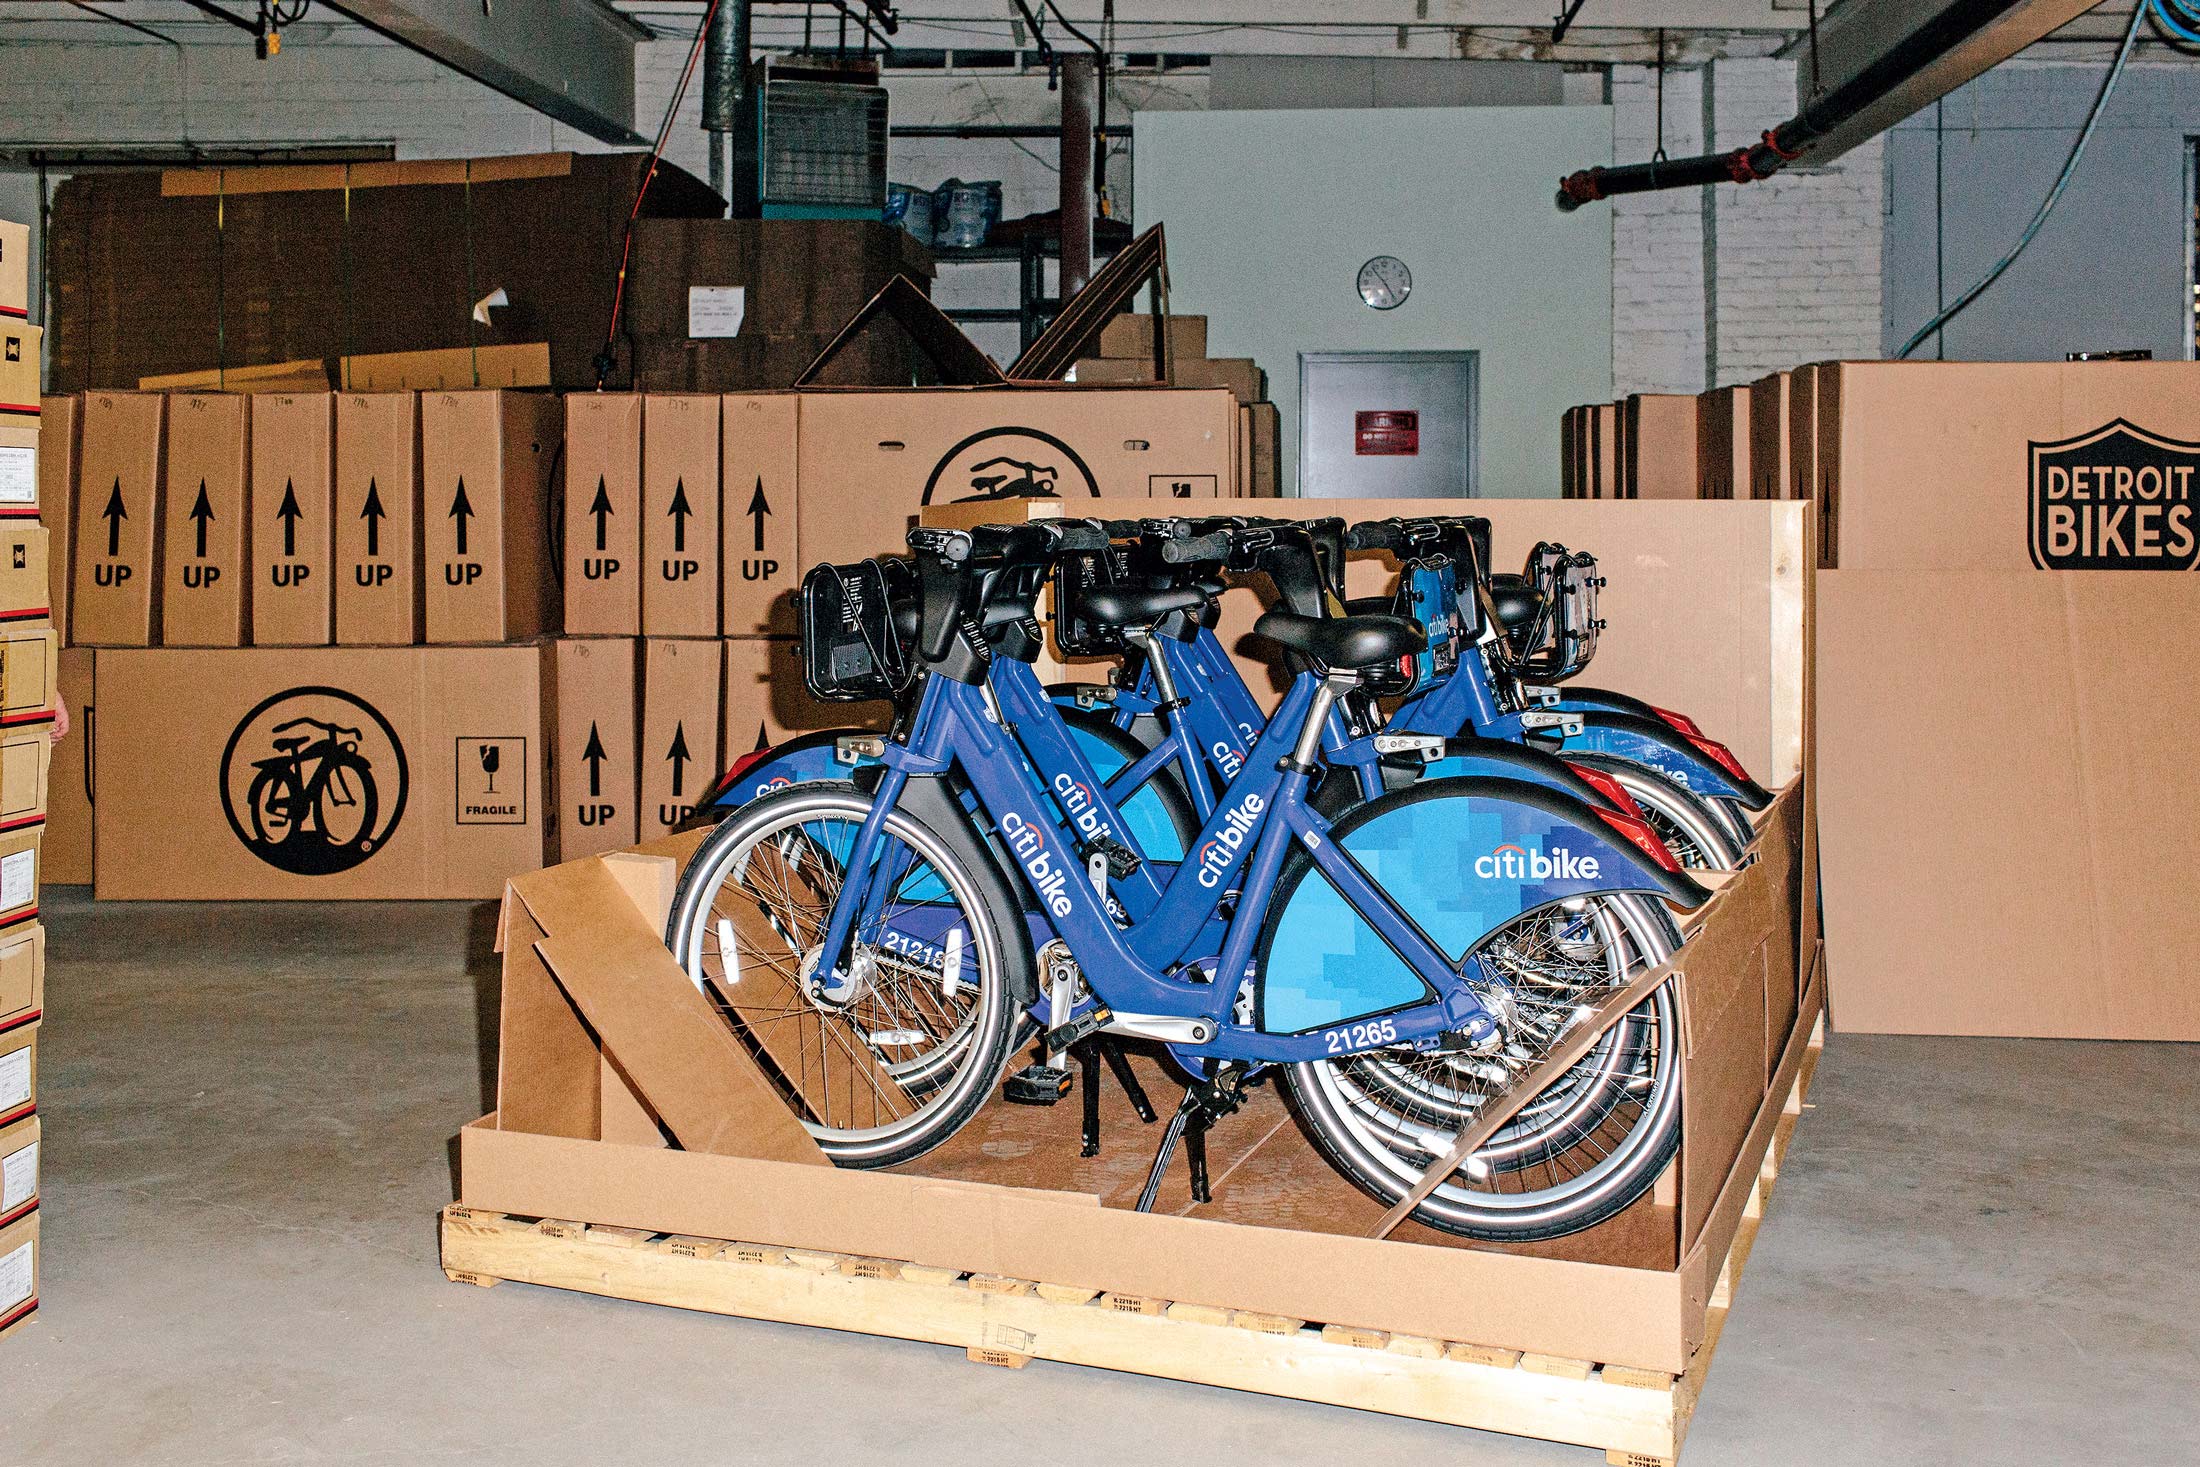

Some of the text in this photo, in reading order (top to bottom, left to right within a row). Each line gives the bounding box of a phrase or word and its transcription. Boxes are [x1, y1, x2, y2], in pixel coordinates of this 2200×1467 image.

[2047, 465, 2195, 500] DETROIT
[2047, 504, 2195, 557] BIKES
[95, 564, 132, 587] UP
[183, 565, 221, 588] UP
[271, 564, 310, 587] UP
[356, 564, 394, 587] UP
[445, 563, 483, 586] UP
[583, 559, 620, 580] UP
[662, 560, 699, 581] UP
[742, 559, 779, 581] UP
[1055, 773, 1092, 815] citi
[465, 805, 517, 815] FRAGILE
[578, 804, 615, 826] UP
[659, 804, 697, 827] UP
[1199, 793, 1265, 888] citi bike
[1002, 812, 1072, 918] citi bike
[1474, 844, 1527, 879] citi
[884, 931, 945, 969] 21218
[1324, 1018, 1397, 1054] 21265
